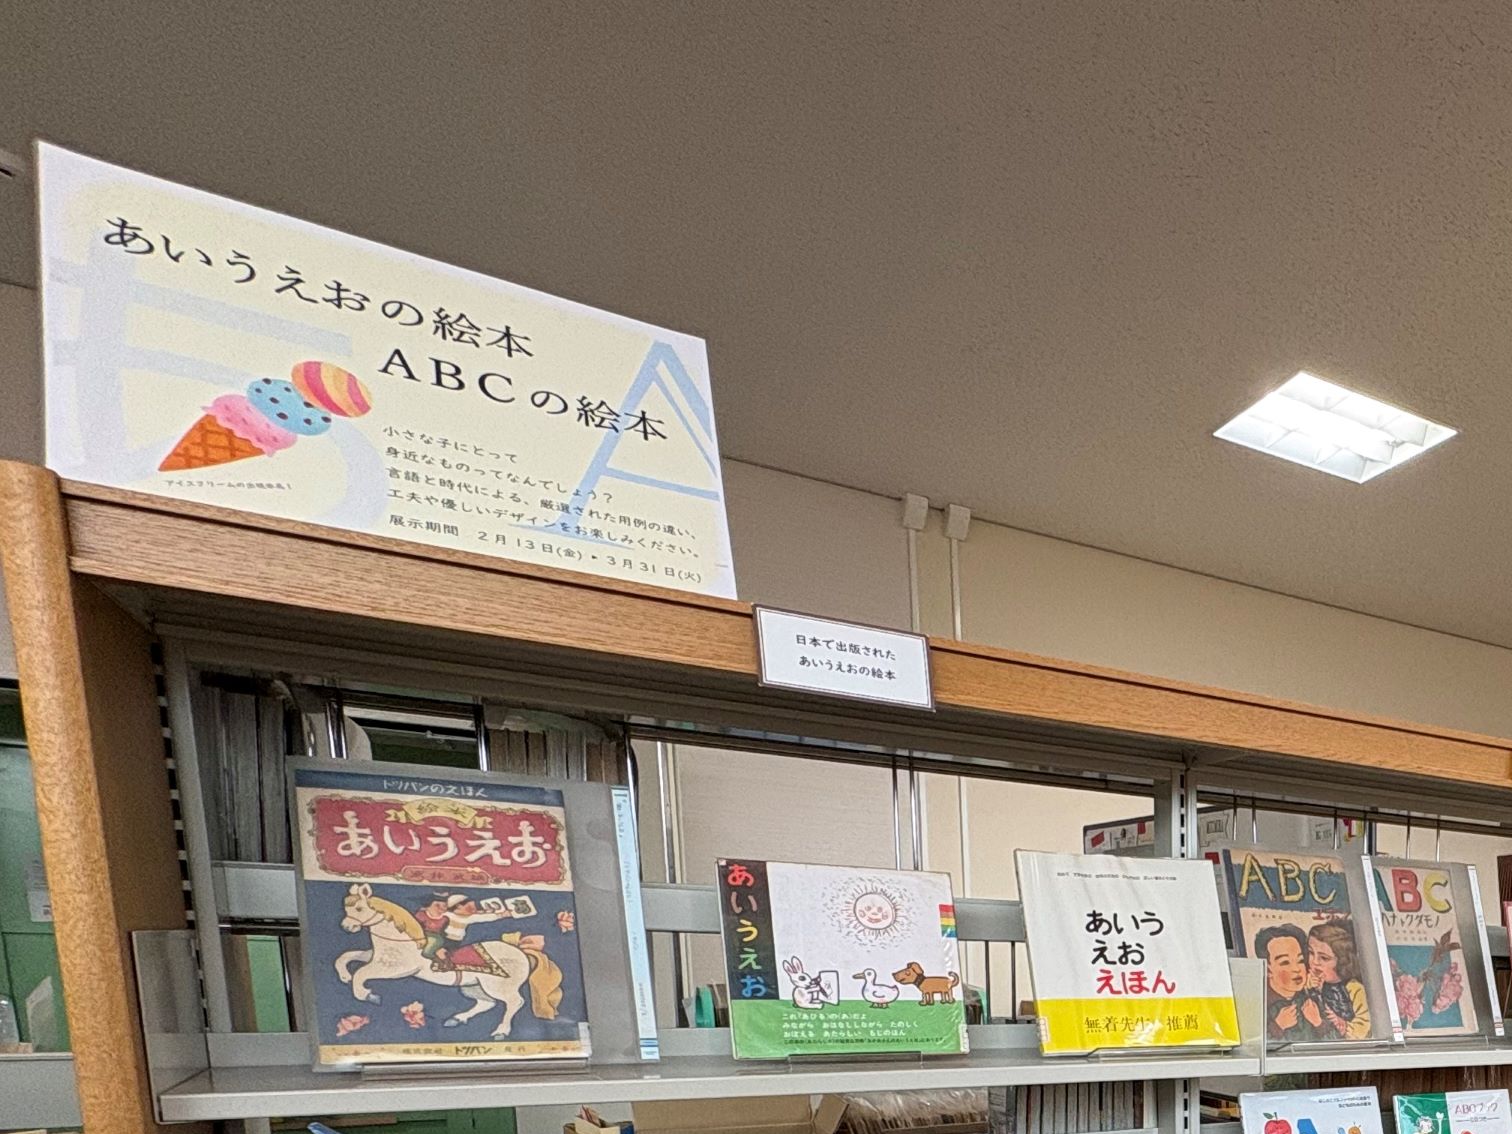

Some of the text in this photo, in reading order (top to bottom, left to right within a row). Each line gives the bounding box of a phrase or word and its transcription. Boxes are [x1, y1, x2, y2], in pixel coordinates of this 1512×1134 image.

[104, 218, 533, 358] あいうえおの絵本
[383, 426, 518, 463] 小さな子にとって
[389, 514, 459, 537] 展示期間
[796, 634, 896, 660] 日本で出版された
[799, 656, 896, 681] あいうえおの絵本
[333, 810, 552, 868] あいうえお
[1239, 852, 1337, 904] ABC
[727, 863, 769, 998] あいうえお
[1085, 909, 1164, 937] あいう
[1090, 940, 1145, 965] えお
[1096, 969, 1176, 994] えほん
